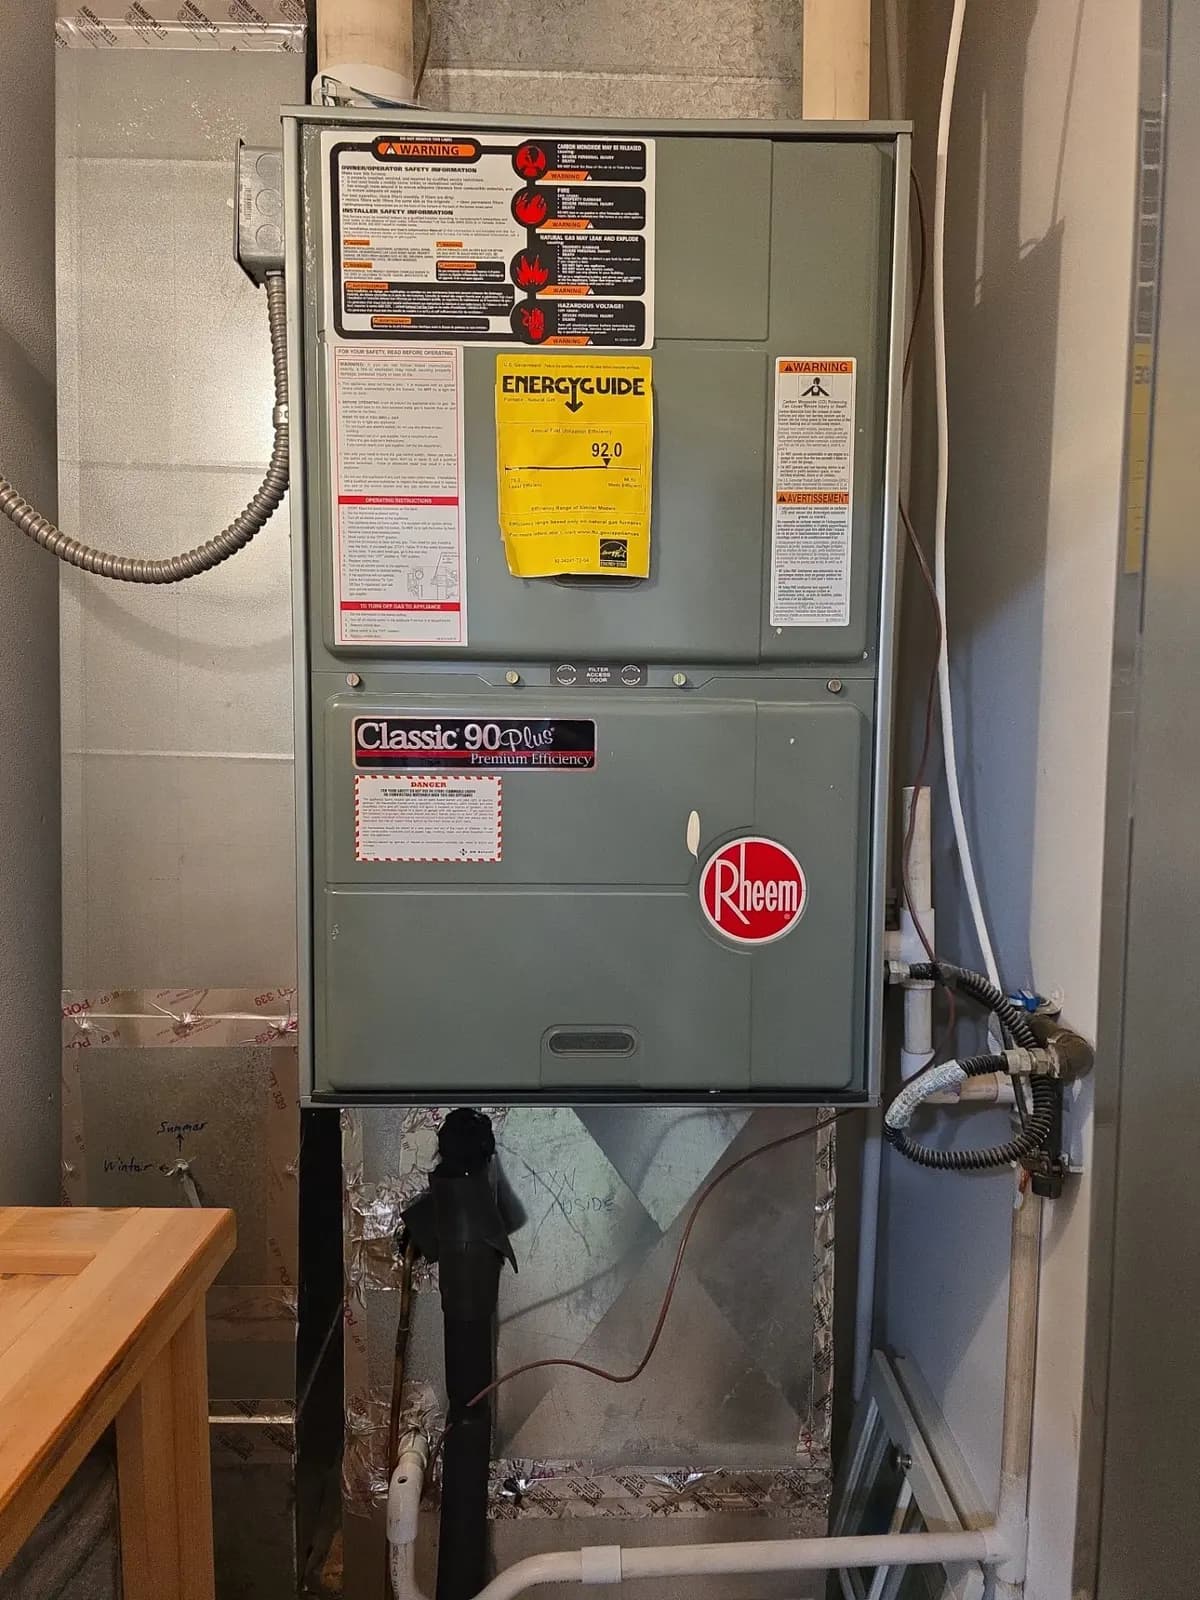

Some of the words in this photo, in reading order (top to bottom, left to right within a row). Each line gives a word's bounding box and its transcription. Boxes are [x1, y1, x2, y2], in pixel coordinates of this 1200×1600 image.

[400, 144, 459, 155] WARNING
[793, 362, 848, 372] WARNING
[502, 375, 645, 396] ENERGYGUIDE
[592, 442, 622, 457] 92.0
[789, 493, 848, 503] AVERTISSEMENT
[356, 722, 458, 750] Classic
[464, 724, 500, 750] 90
[499, 729, 553, 752] Plus
[470, 754, 527, 764] Premium
[532, 754, 592, 767] Efficiency
[714, 843, 798, 924] Rheem
[254, 992, 274, 1006] 339
[156, 1121, 208, 1134] Summer
[103, 1158, 152, 1173] Winter
